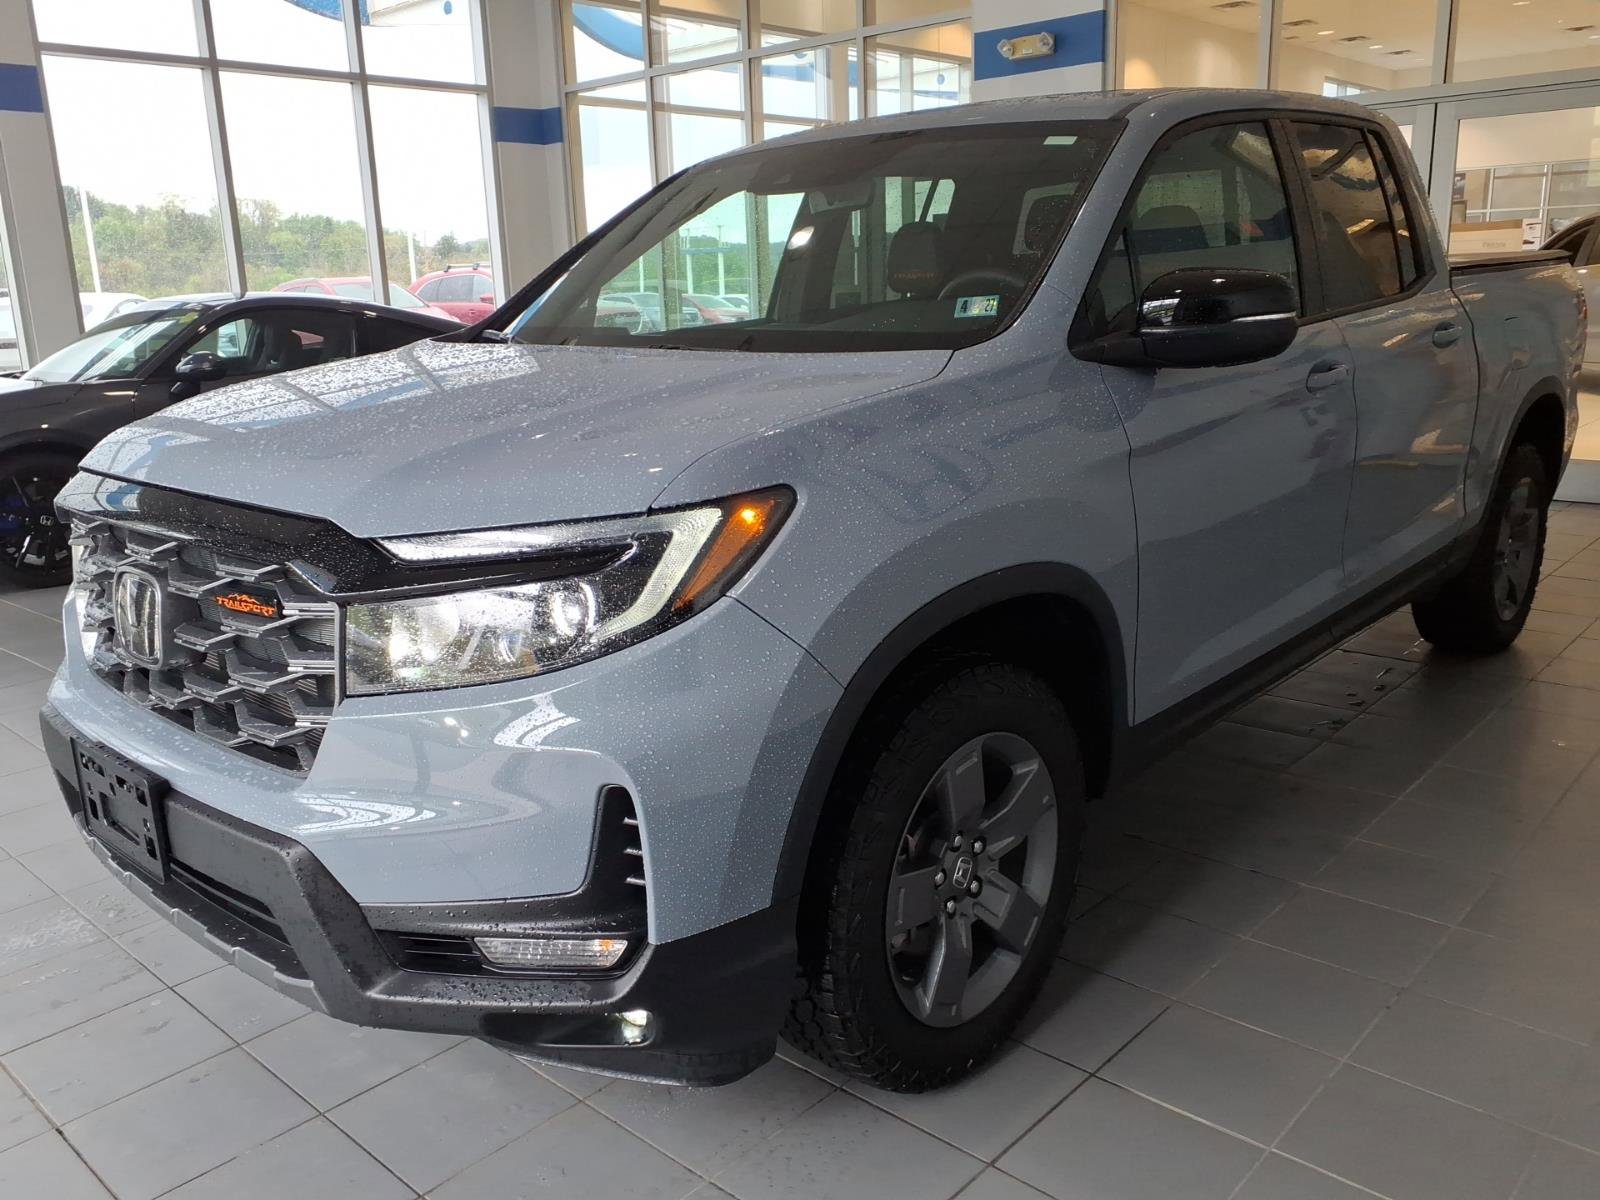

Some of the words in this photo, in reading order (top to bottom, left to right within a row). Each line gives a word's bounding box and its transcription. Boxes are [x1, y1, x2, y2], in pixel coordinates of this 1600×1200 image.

[960, 300, 969, 313] 4
[984, 298, 996, 312] 27
[216, 596, 276, 617] TRAILSPORT
